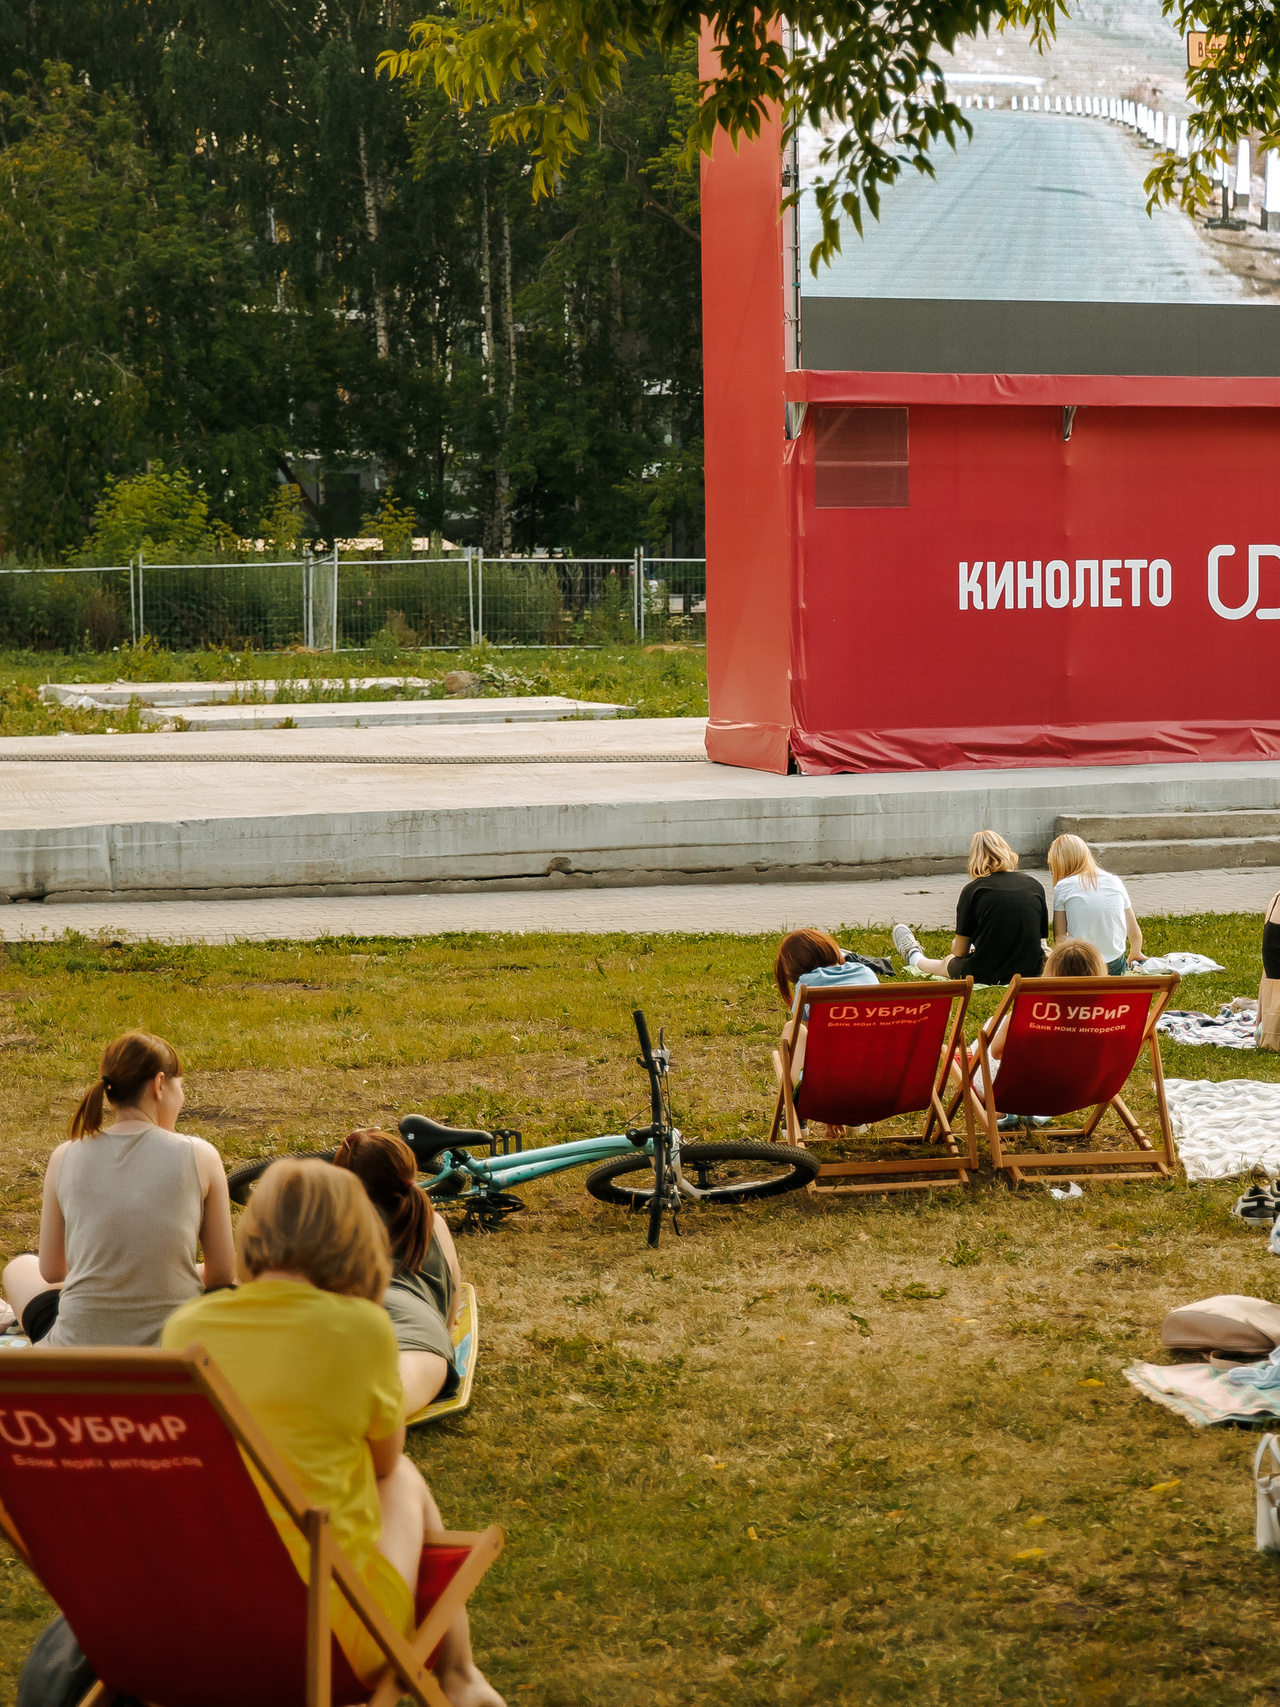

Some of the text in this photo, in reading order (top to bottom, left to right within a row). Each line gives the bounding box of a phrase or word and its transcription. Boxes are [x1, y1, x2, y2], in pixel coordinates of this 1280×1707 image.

[958, 558, 1172, 611] КИНОЛЕТО
[865, 1002, 932, 1018] УБРиР
[1066, 1004, 1130, 1020] УБРиР
[1029, 1022, 1052, 1031] Банк
[1079, 1024, 1126, 1034] интересов
[56, 1414, 188, 1444] УБРиР
[12, 1454, 57, 1469] Банк
